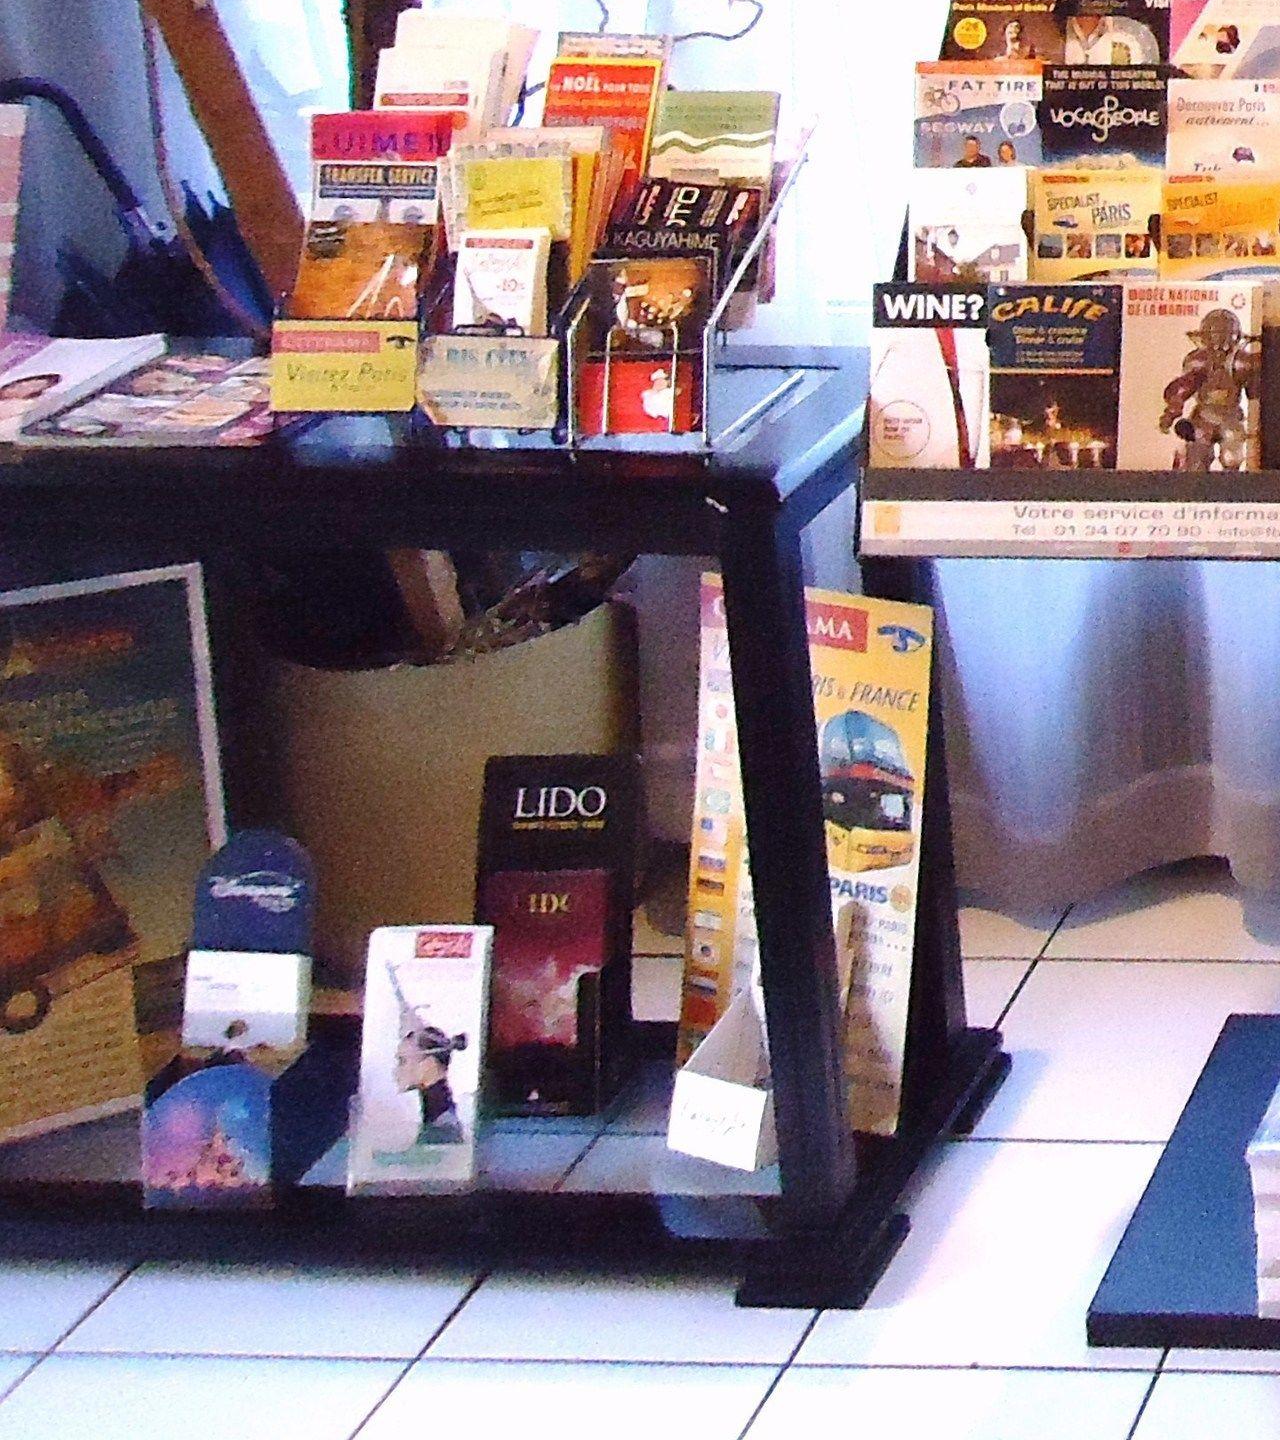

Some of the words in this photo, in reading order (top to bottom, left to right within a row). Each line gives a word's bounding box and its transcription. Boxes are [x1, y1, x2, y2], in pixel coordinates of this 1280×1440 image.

[949, 81, 984, 92] FAT
[995, 81, 1038, 92] TIRE
[883, 293, 984, 321] WINE?
[1014, 505, 1074, 520] Votre
[1084, 506, 1164, 520] service
[849, 681, 921, 713] FRANCE
[513, 786, 607, 818] LIDO
